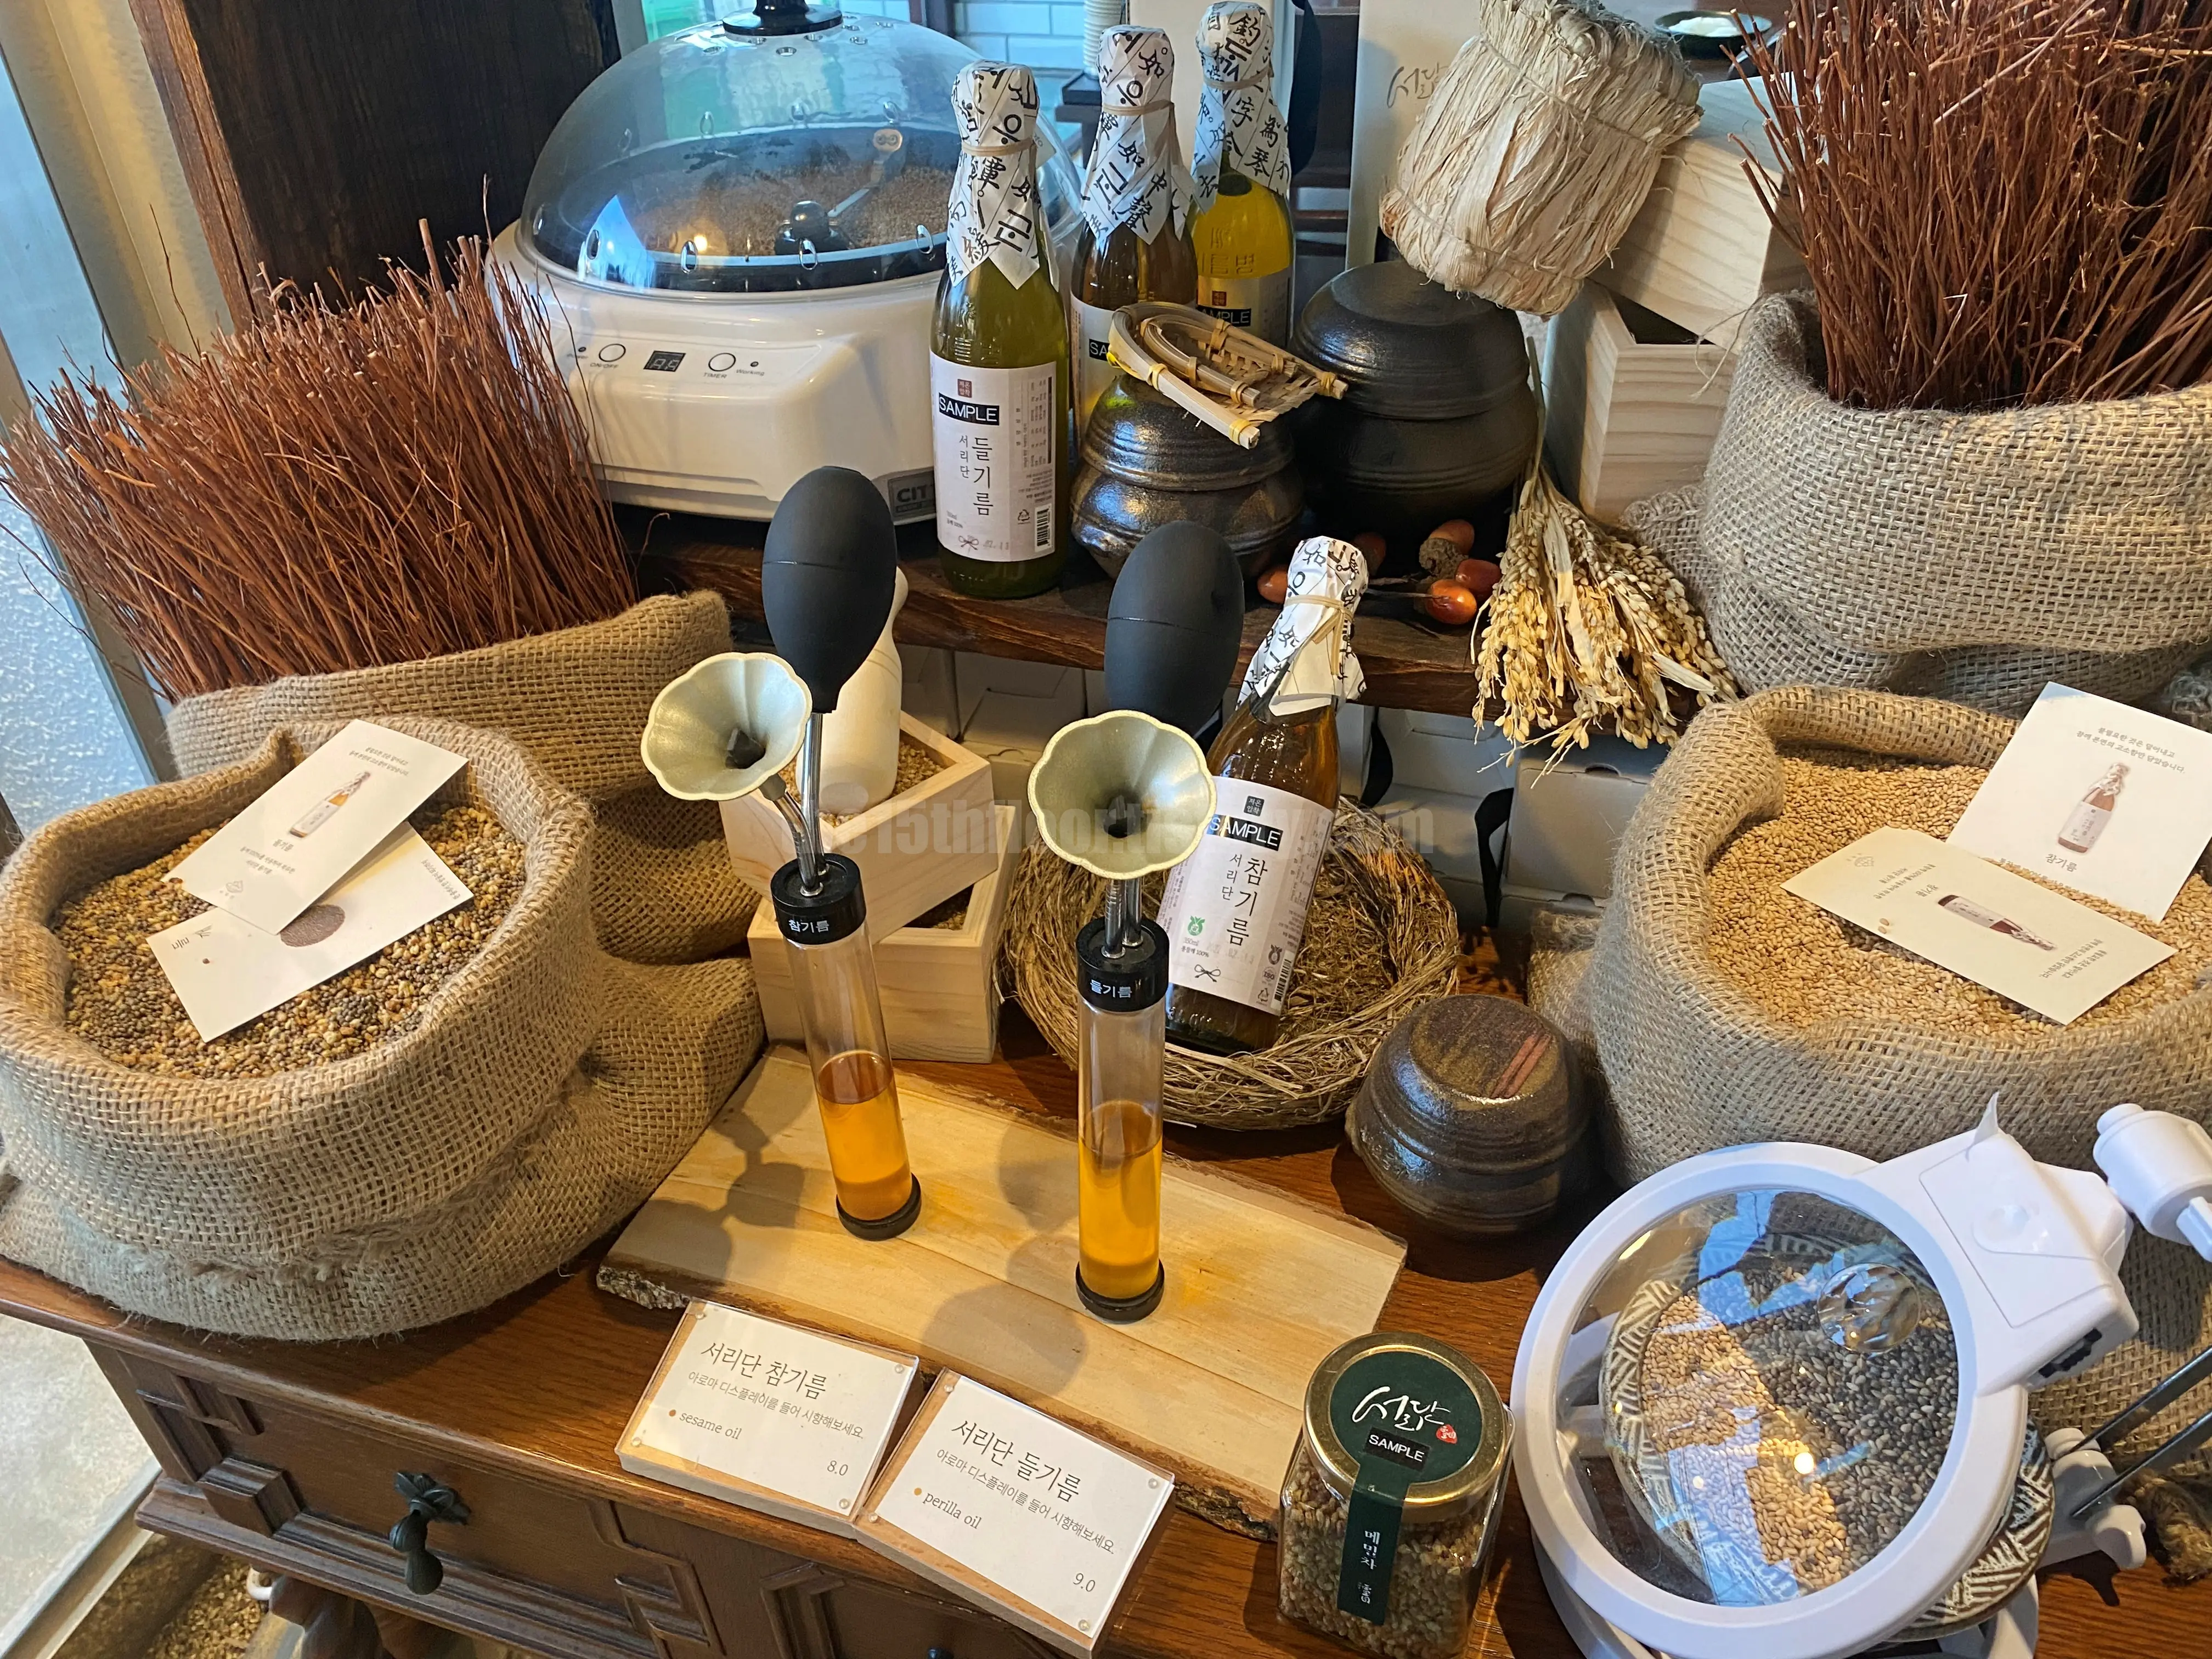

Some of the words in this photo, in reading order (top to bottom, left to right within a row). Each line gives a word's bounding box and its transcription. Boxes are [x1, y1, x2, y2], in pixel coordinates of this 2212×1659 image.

[939, 396, 998, 422] SAMPLE
[959, 435, 970, 479] 서리단
[972, 436, 994, 516] 들기름
[1209, 816, 1282, 847] SAMPLE
[1221, 853, 1242, 900] 서리단
[2044, 852, 2079, 873] 참기름
[1226, 857, 1268, 946] 참기름
[788, 919, 830, 933] 참기름
[1090, 979, 1132, 998] 들기름
[700, 1342, 761, 1378] 서리단
[765, 1360, 827, 1399] 참기름
[689, 1372, 718, 1390] 아로마
[719, 1380, 779, 1410] 디스플레이를
[780, 1402, 800, 1418] 들어
[802, 1408, 864, 1440] 시향해보세요.
[680, 1412, 723, 1434] sesame
[725, 1426, 742, 1440] oil
[951, 1420, 1013, 1466] 서리단
[1017, 1452, 1082, 1502] 들기름
[1368, 1434, 1425, 1462] SAMPLE
[826, 1460, 849, 1476] 8.0
[923, 1491, 962, 1521] perilla
[963, 1511, 982, 1530] oil
[936, 1449, 967, 1474] 아로마
[967, 1466, 1027, 1506] 디스플레이를
[1028, 1499, 1051, 1518] 들어
[1052, 1509, 1115, 1555] 시향해보세요.
[1073, 1573, 1096, 1593] 9.0
